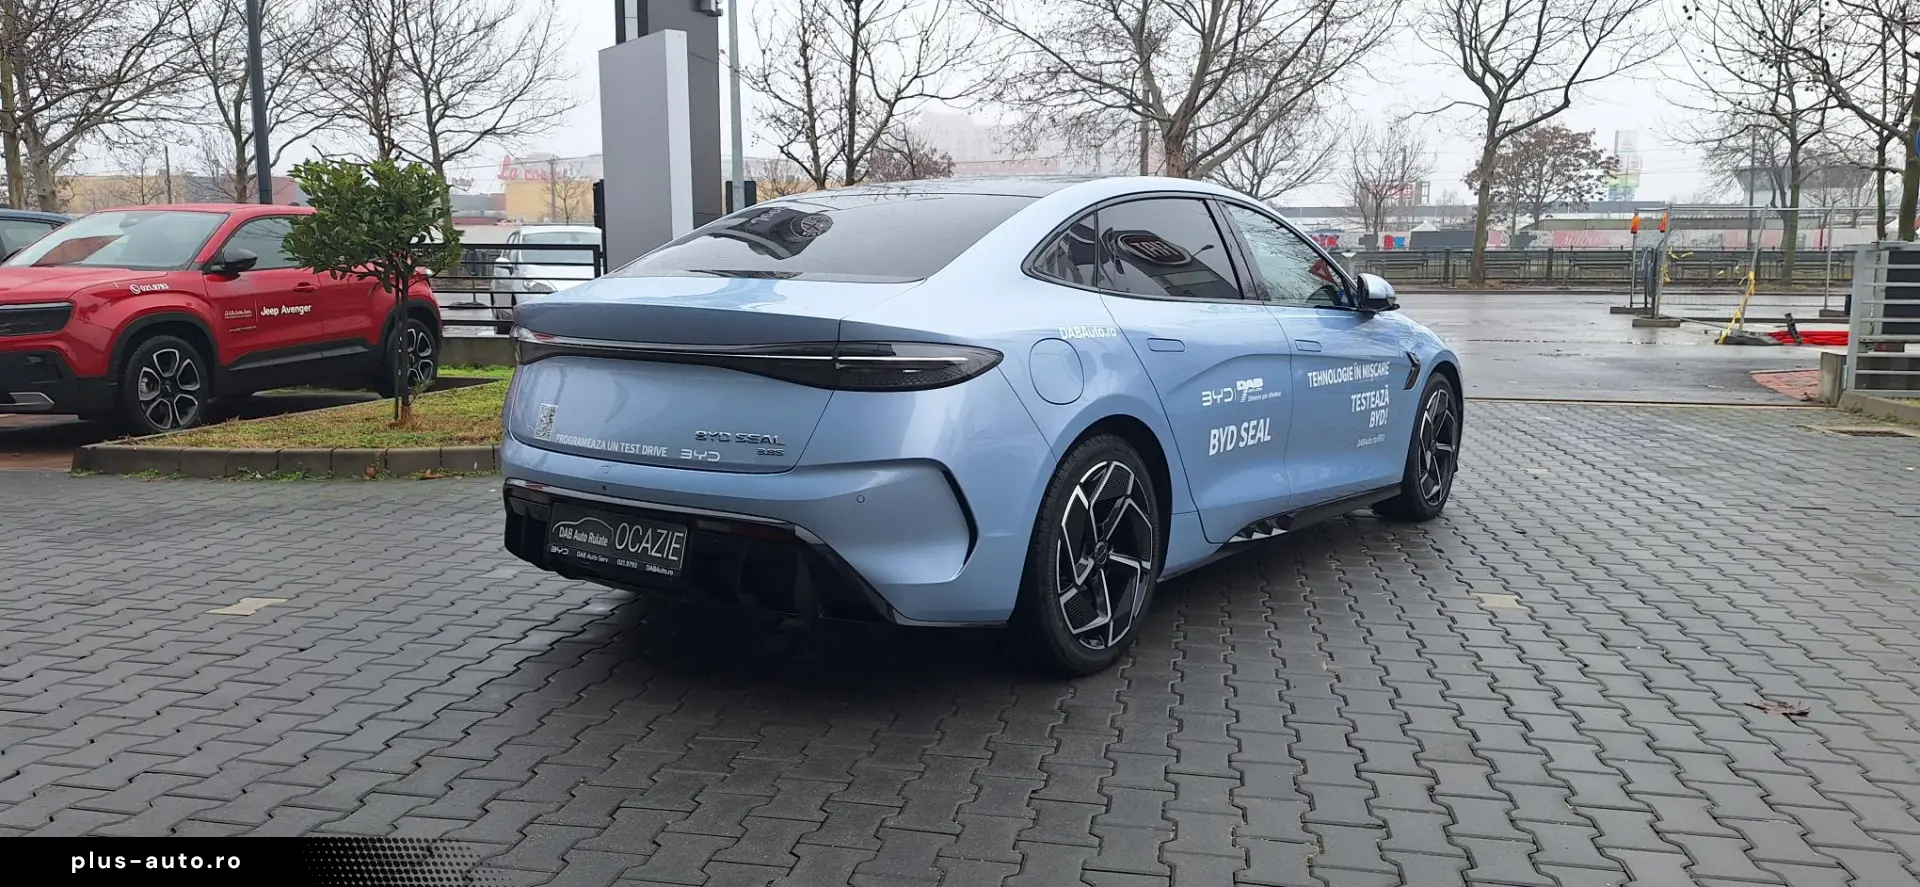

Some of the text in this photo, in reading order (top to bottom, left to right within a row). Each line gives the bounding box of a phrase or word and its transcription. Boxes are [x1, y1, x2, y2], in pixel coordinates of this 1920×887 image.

[260, 306, 279, 317] Jeep
[280, 304, 312, 316] Avenger
[1058, 326, 1117, 340] DABAuto.ro
[1307, 366, 1354, 388] TEHNOLOGIE
[1353, 362, 1362, 380] ÎN
[1236, 377, 1263, 391] DAB
[1201, 387, 1234, 407] BYD
[1350, 384, 1390, 412] TESTEAZĂ
[1369, 408, 1388, 428] BYD!
[695, 430, 785, 446] BYD SEAL
[1208, 417, 1272, 456] BYD SEAL
[555, 433, 668, 457] PROGRAMEAZA UN TEST DRIVE
[680, 448, 720, 462] BYD
[558, 526, 608, 547] DAB Auto Rulate
[615, 522, 685, 561] OCAZIE
[550, 545, 569, 556] BYD
[586, 552, 598, 561] Auto
[598, 554, 608, 563] Serv
[616, 558, 638, 569] 021.9793
[646, 564, 674, 576] DABAuto.ro
